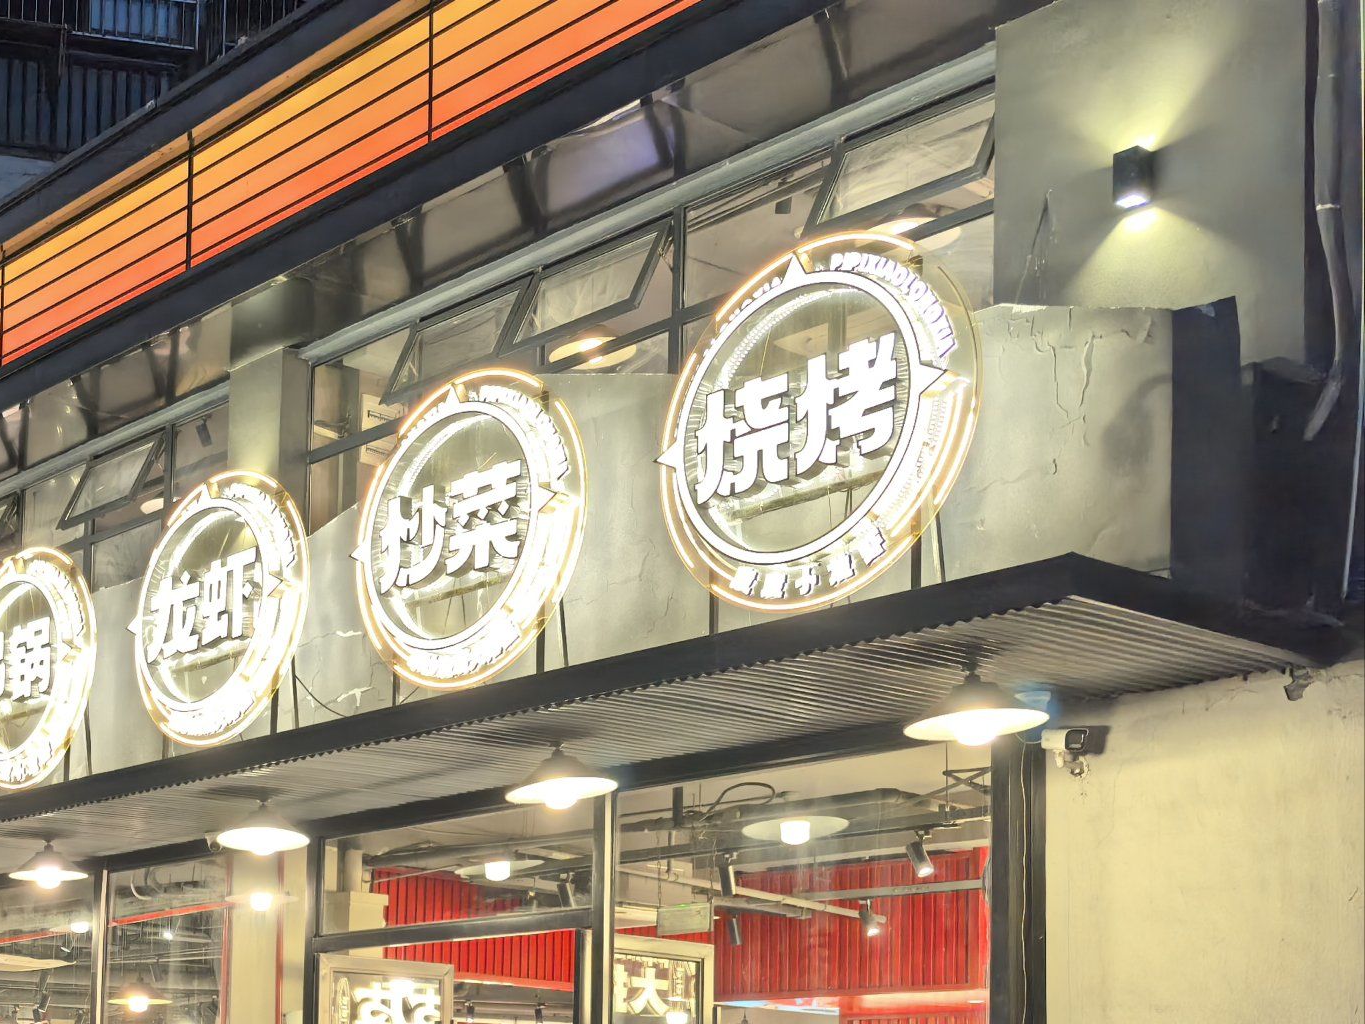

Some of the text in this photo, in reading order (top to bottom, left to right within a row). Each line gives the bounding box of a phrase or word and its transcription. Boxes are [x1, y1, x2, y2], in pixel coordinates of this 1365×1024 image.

[696, 332, 899, 504] 烧烤
[380, 460, 522, 595] 炒菜
[147, 546, 257, 664] 龙虾
